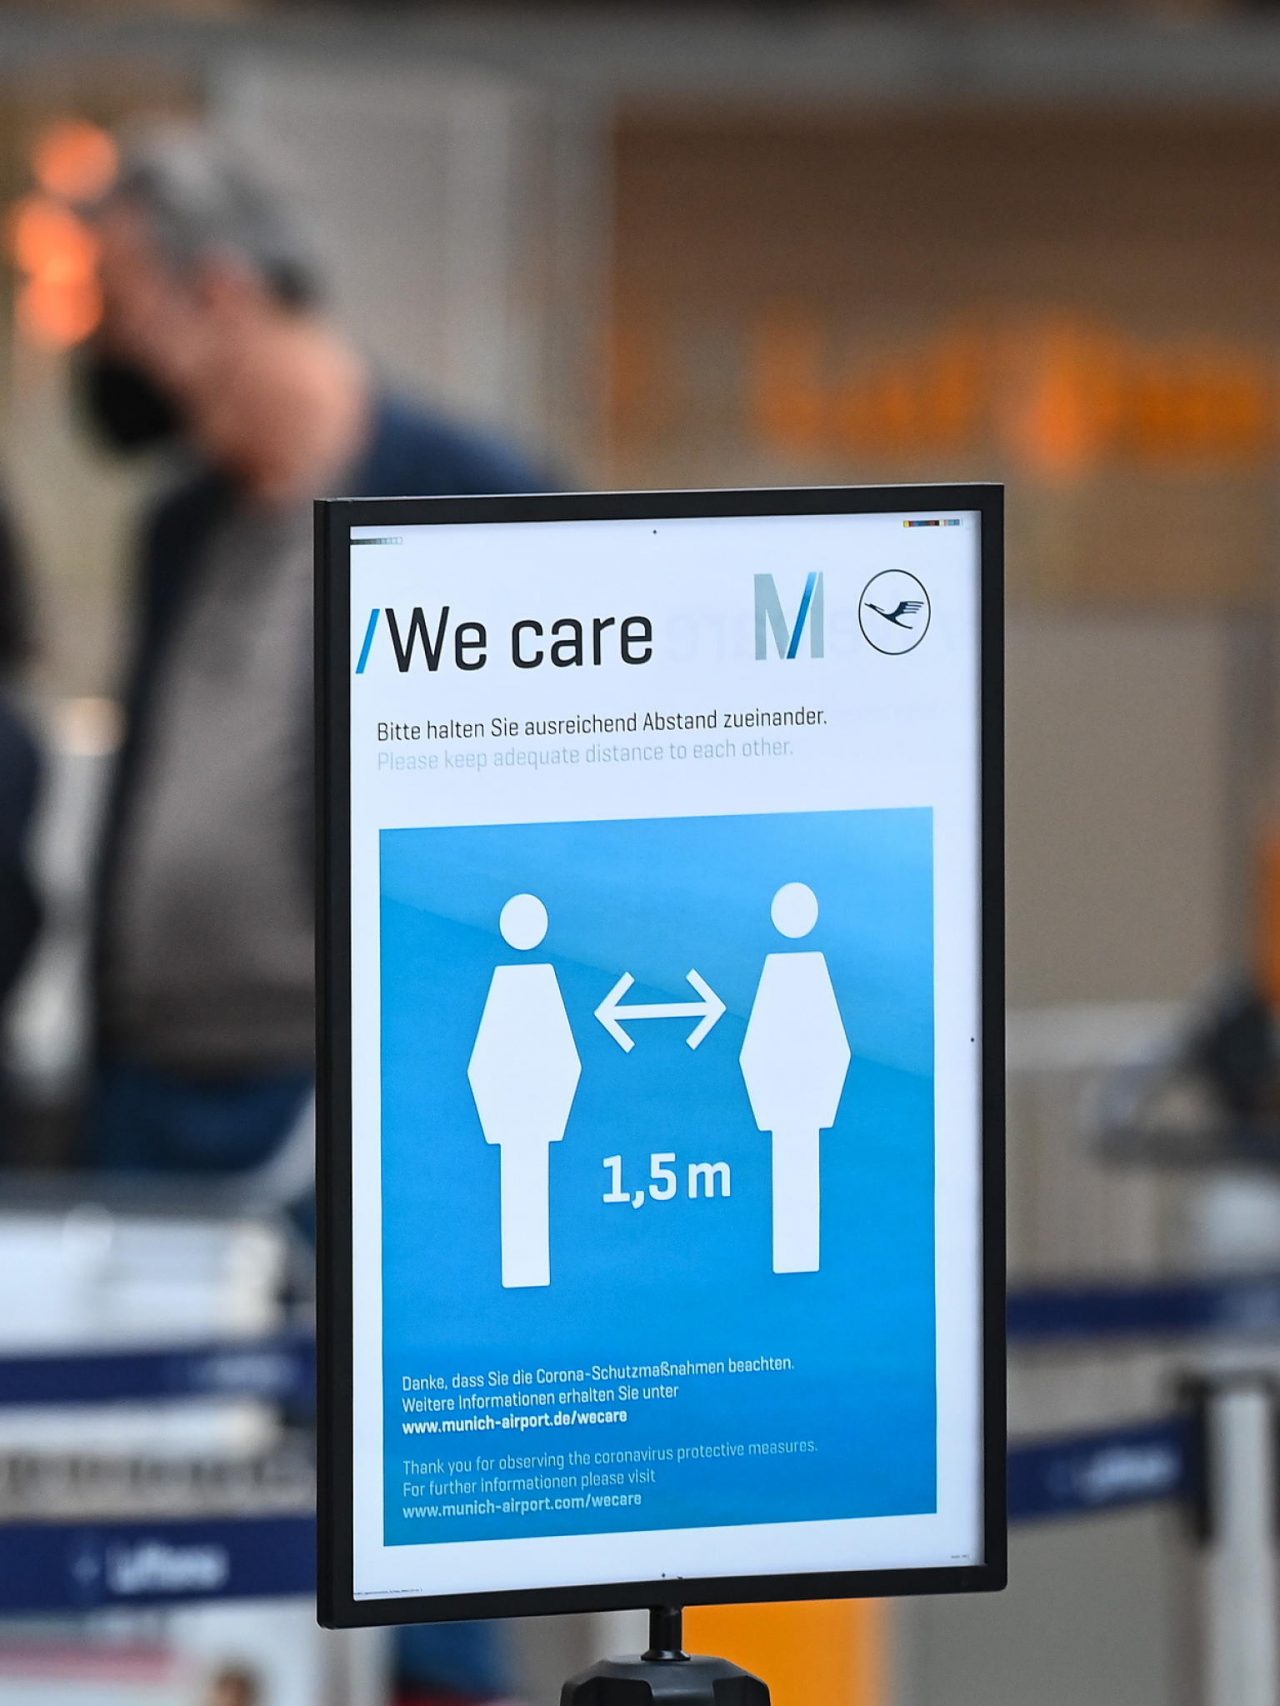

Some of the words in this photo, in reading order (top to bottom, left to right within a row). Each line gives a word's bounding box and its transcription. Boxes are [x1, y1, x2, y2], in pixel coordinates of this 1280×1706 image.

[511, 615, 653, 670] care
[377, 720, 421, 742] Bitte
[426, 718, 485, 741] halten
[490, 715, 519, 739] Sie
[524, 711, 637, 737] ausreichend
[642, 708, 717, 732] Abstand
[723, 704, 828, 730] zueinander.
[377, 750, 439, 772] Please
[444, 748, 488, 773] keep
[492, 745, 581, 772] adequate
[585, 742, 664, 765] distance
[667, 741, 688, 761] to
[692, 737, 737, 761] each
[741, 736, 794, 760] other.
[602, 1152, 677, 1209] 1,5
[688, 1161, 731, 1199] m
[401, 1373, 449, 1394] Danke,
[451, 1372, 485, 1390] dass
[487, 1369, 510, 1388] Sie
[512, 1367, 533, 1387] die
[536, 1359, 725, 1385] Corona-Schutzmaßnahmen
[728, 1354, 795, 1374] beachten.
[401, 1395, 456, 1414] Weitere
[458, 1390, 556, 1411] Informationen
[558, 1386, 615, 1406] erhalten
[617, 1384, 640, 1402] Sie
[642, 1383, 680, 1400] unter
[401, 1408, 628, 1436] www.munich-airport.de/wecare
[402, 1457, 445, 1476] Thank
[447, 1459, 472, 1478] you
[475, 1454, 496, 1473] for
[498, 1450, 565, 1472] observing
[568, 1449, 591, 1467] the
[594, 1445, 674, 1466] coronavirus
[676, 1440, 745, 1465] protective
[748, 1439, 818, 1456] measures.
[402, 1480, 426, 1498] For
[429, 1478, 478, 1497] further
[480, 1473, 578, 1494] informationen
[580, 1470, 625, 1492] please
[627, 1467, 656, 1485] visit
[402, 1492, 642, 1520] www.munich-airport.com/wecare
